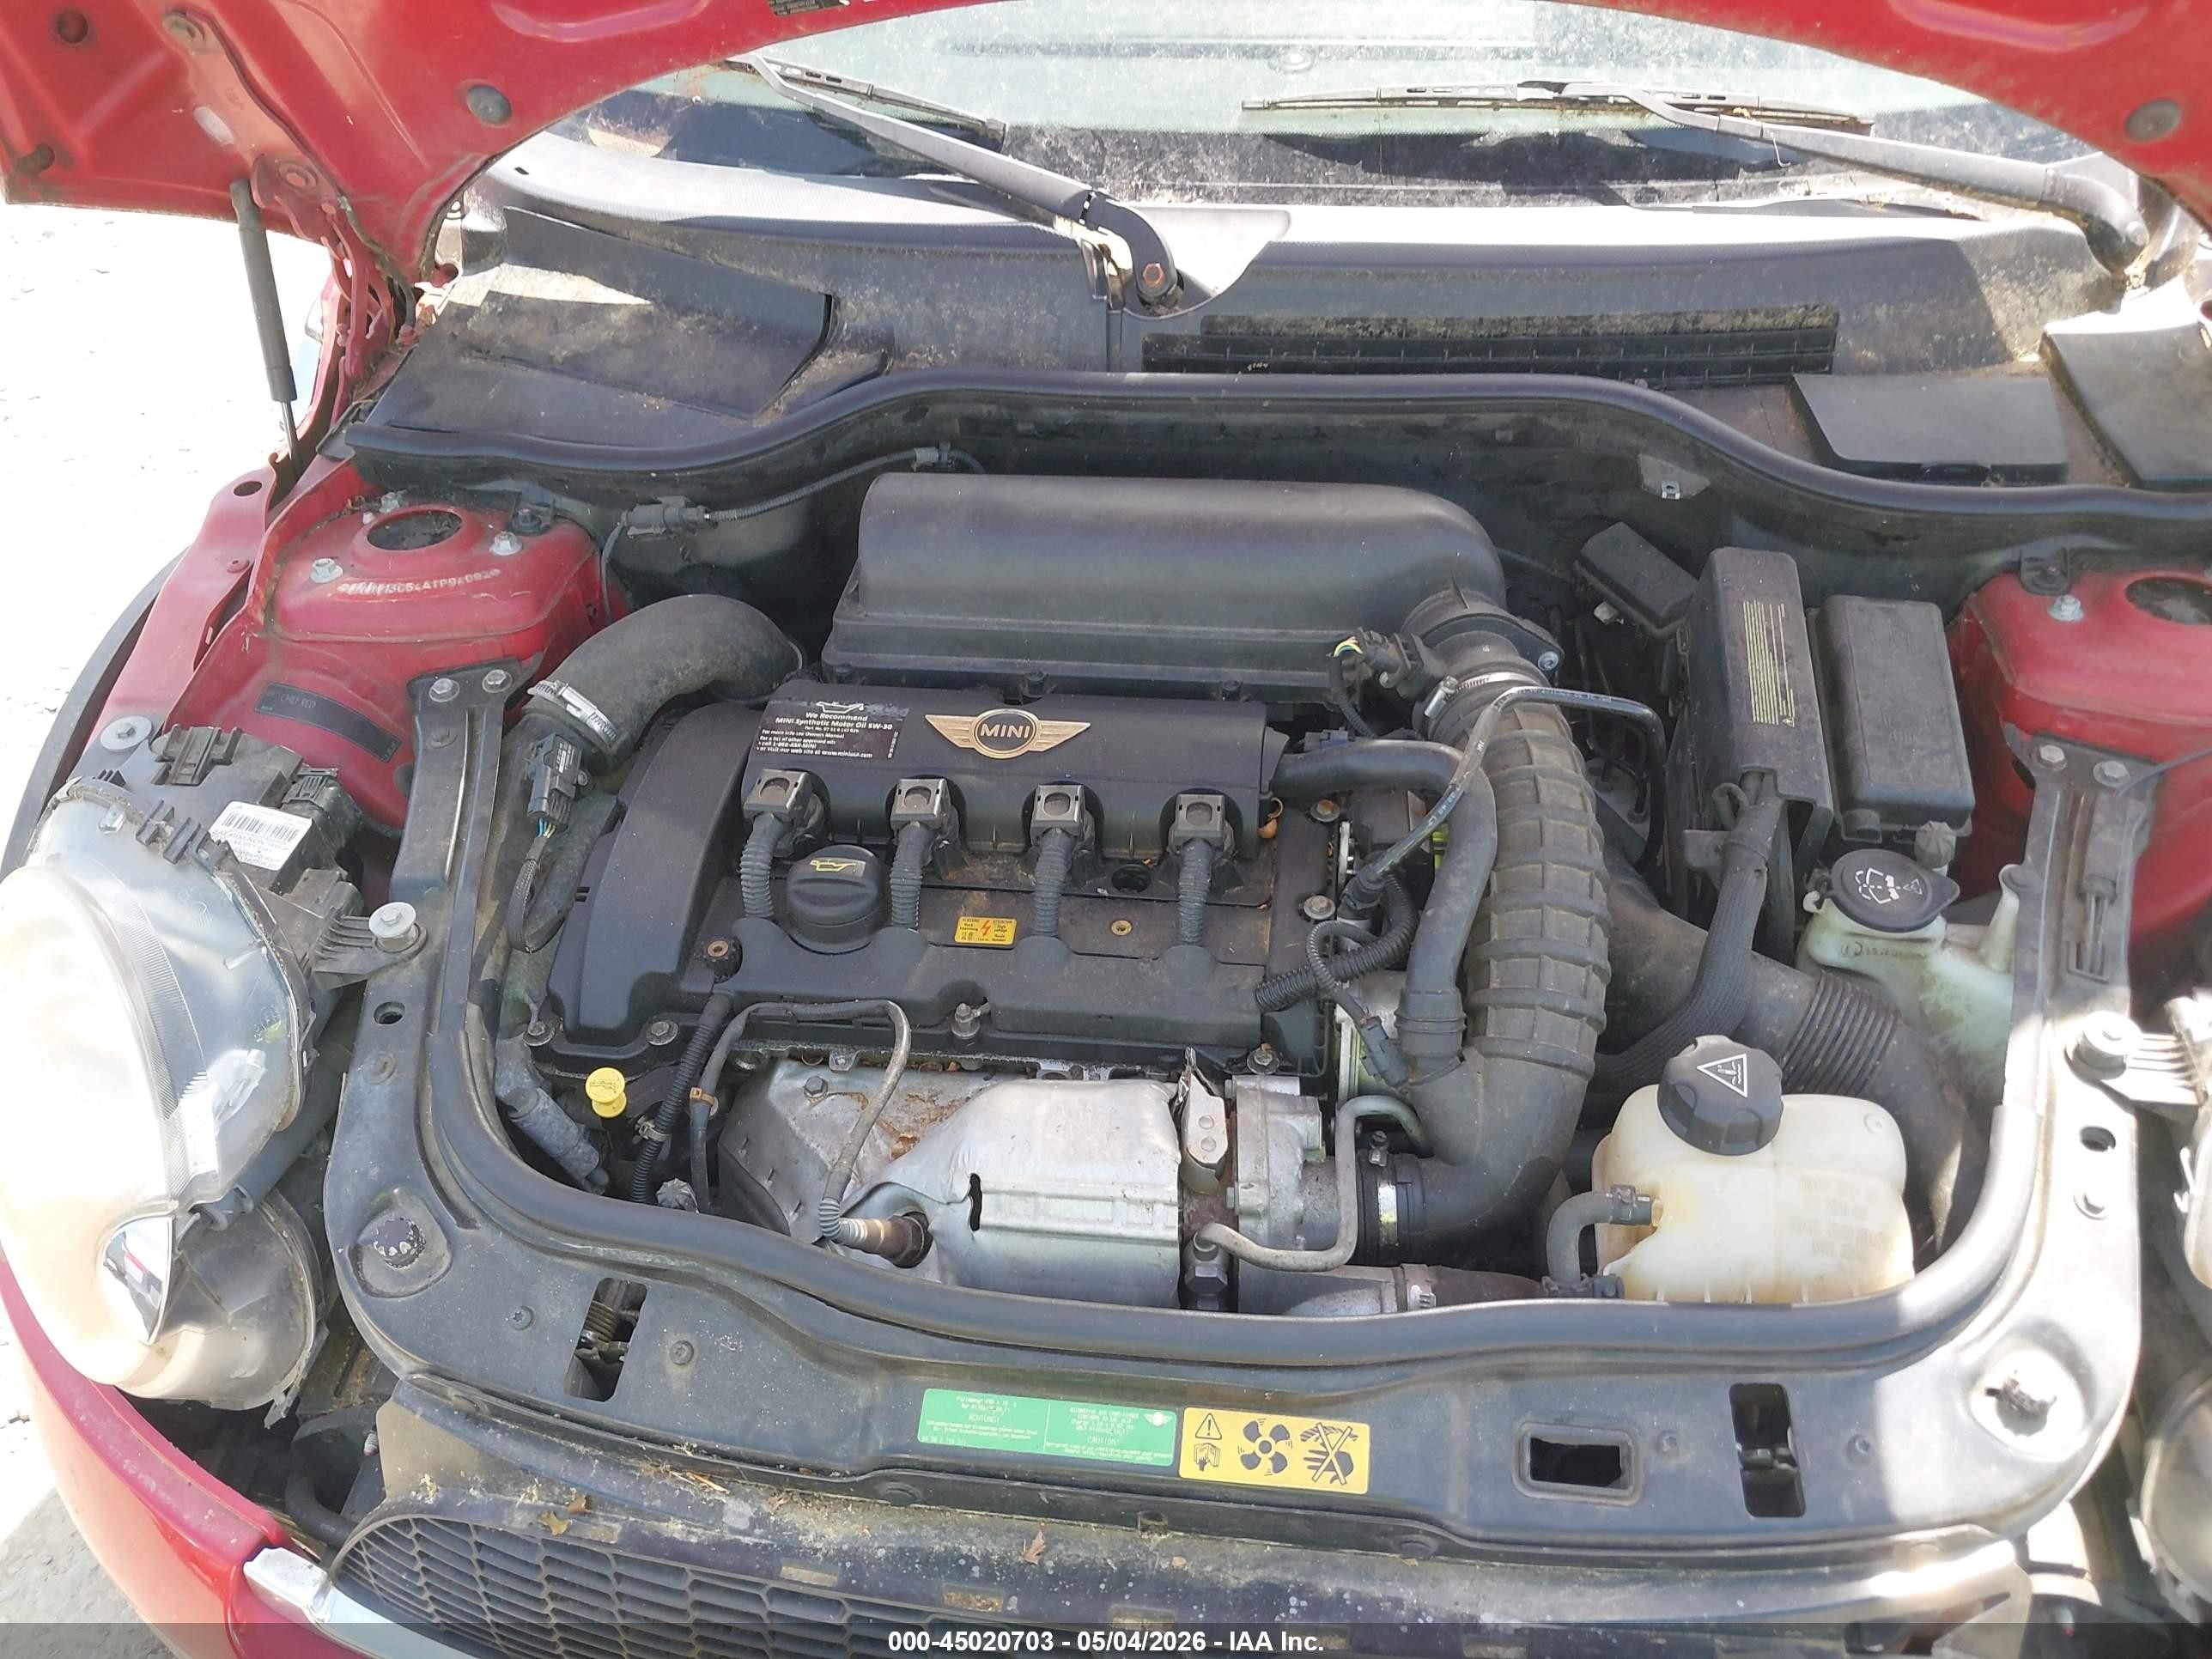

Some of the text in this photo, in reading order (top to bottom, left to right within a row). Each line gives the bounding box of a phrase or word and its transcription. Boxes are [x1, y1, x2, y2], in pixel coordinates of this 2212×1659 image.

[819, 713, 868, 721] Recommend
[795, 718, 830, 726] Synthetic
[831, 720, 855, 728] Motor
[980, 723, 1030, 738] MINI
